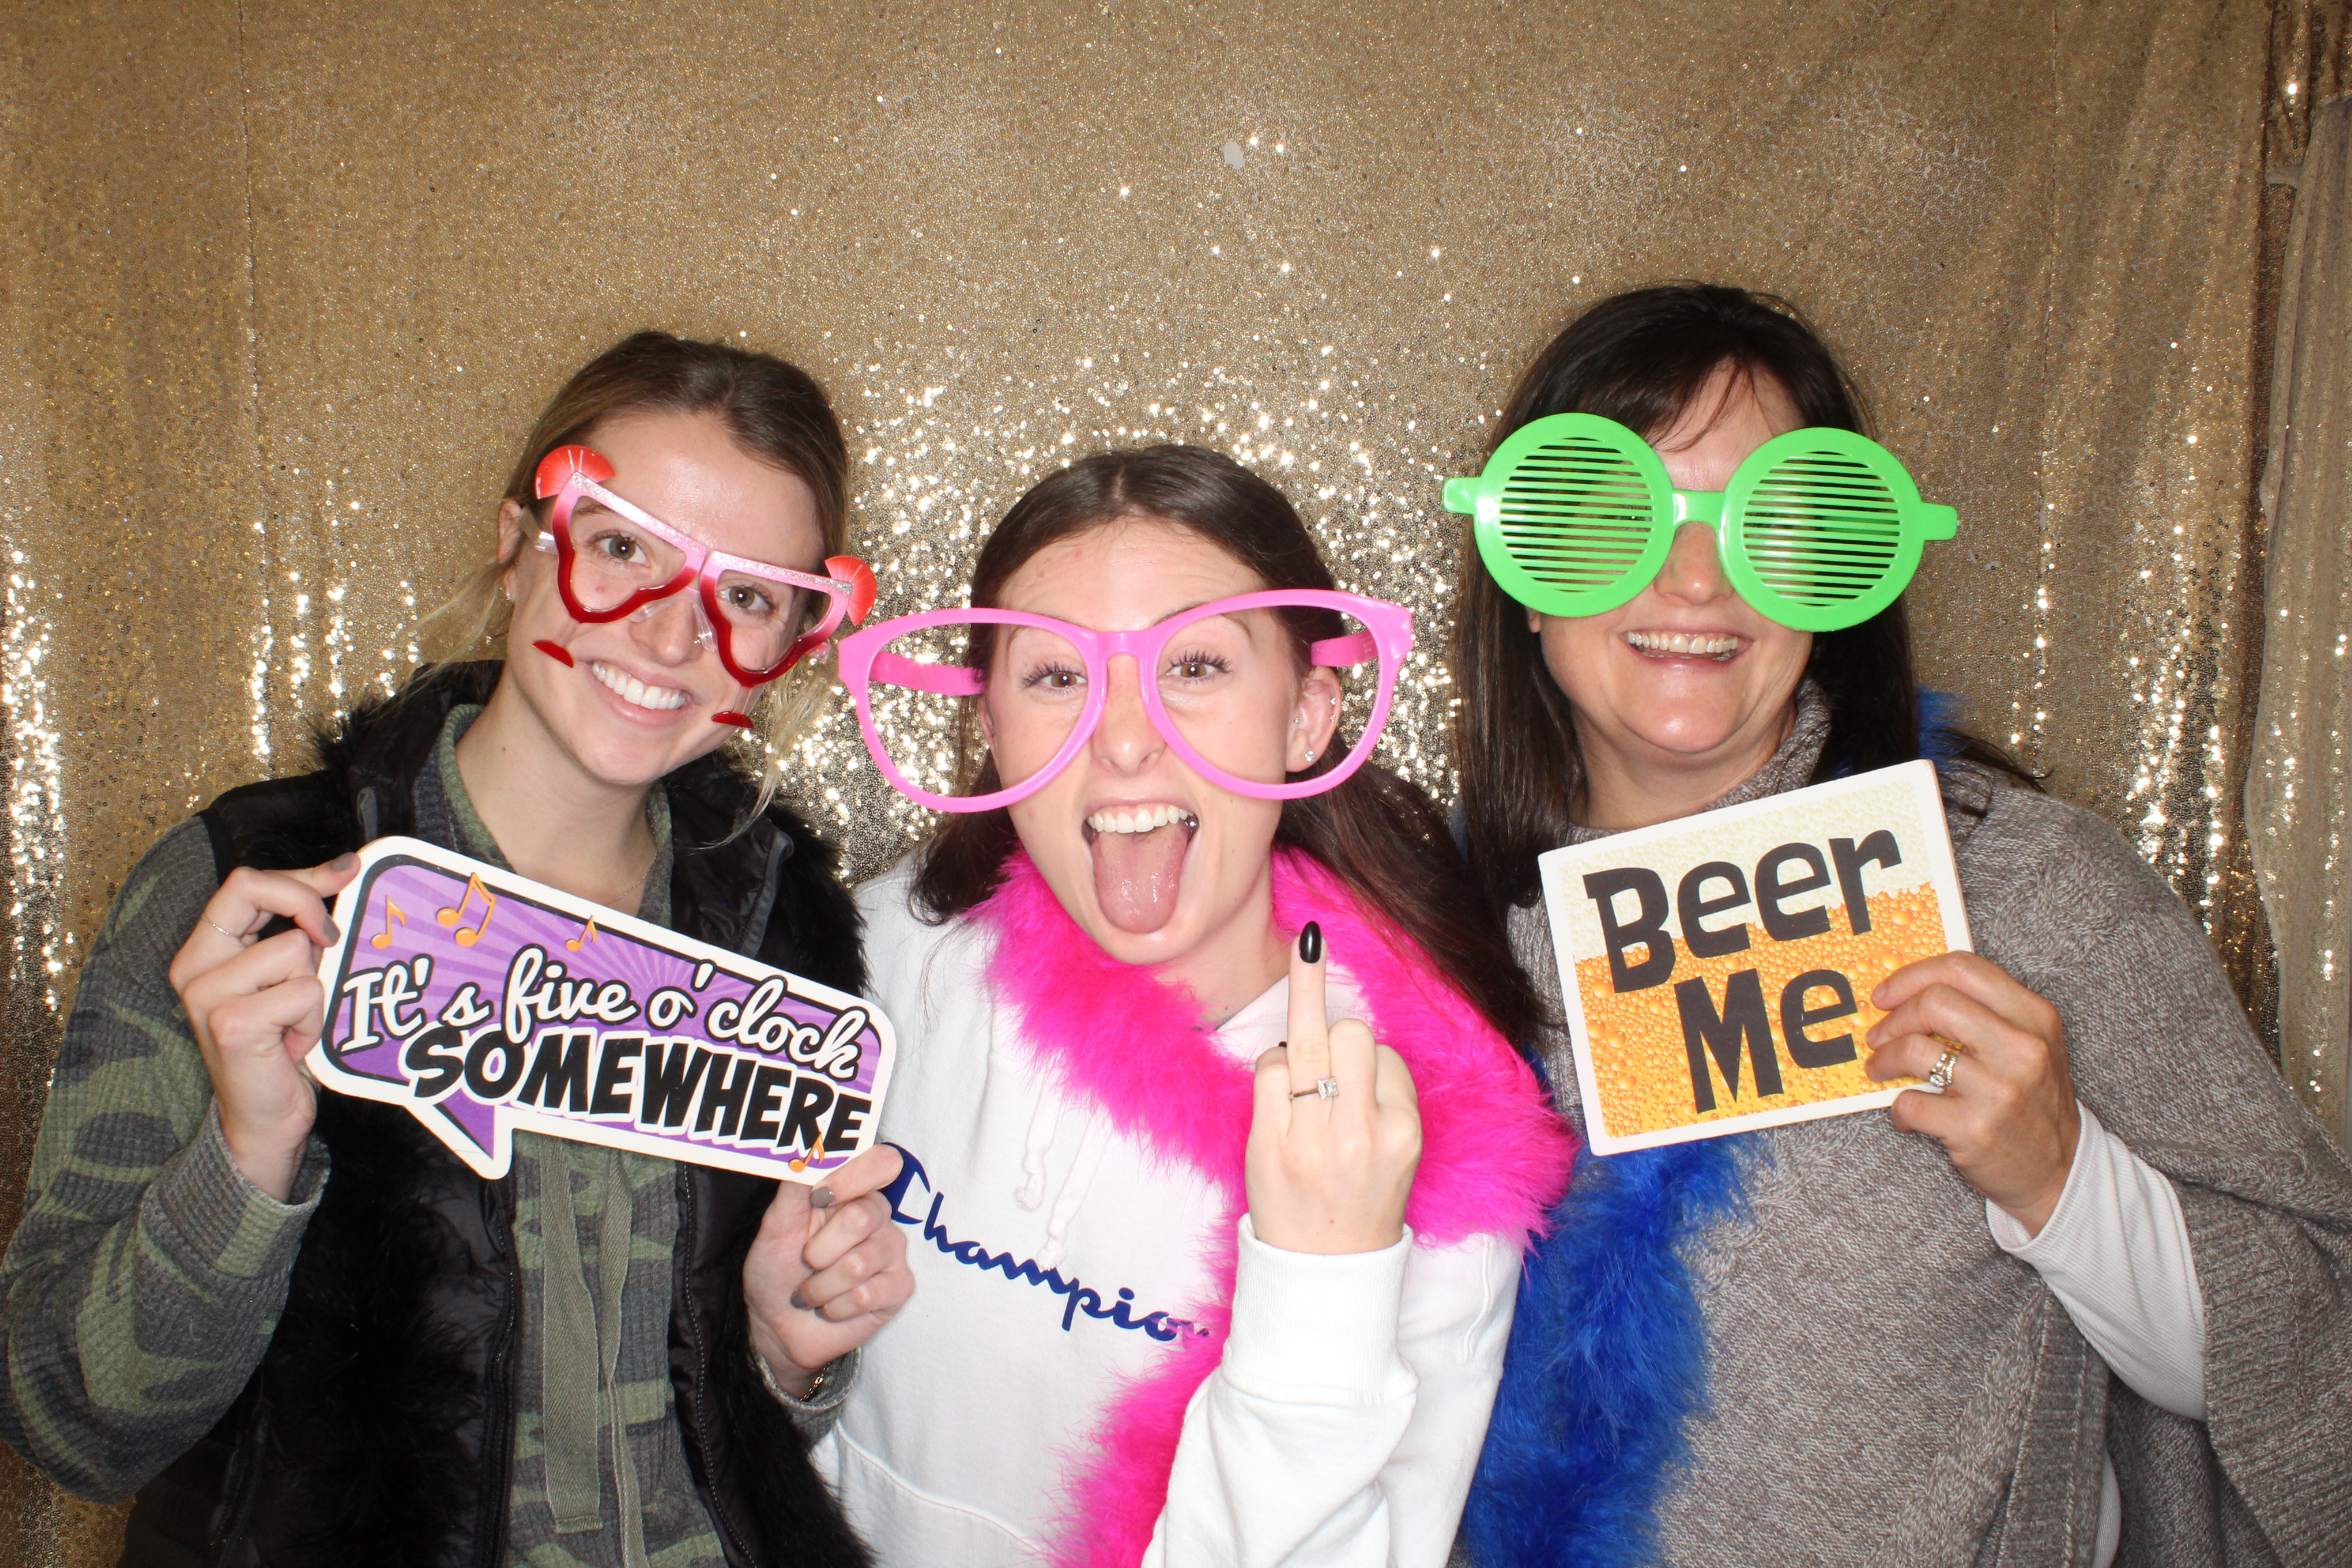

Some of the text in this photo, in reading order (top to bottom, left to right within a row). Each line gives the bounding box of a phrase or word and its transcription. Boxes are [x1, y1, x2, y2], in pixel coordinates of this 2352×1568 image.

[1582, 830, 1901, 994] Beer
[340, 958, 491, 1051] It's
[506, 948, 636, 1040] five
[1673, 968, 1859, 1114] Me
[406, 1026, 872, 1154] SOMEWHERE
[878, 1142, 1210, 1341] Champio
